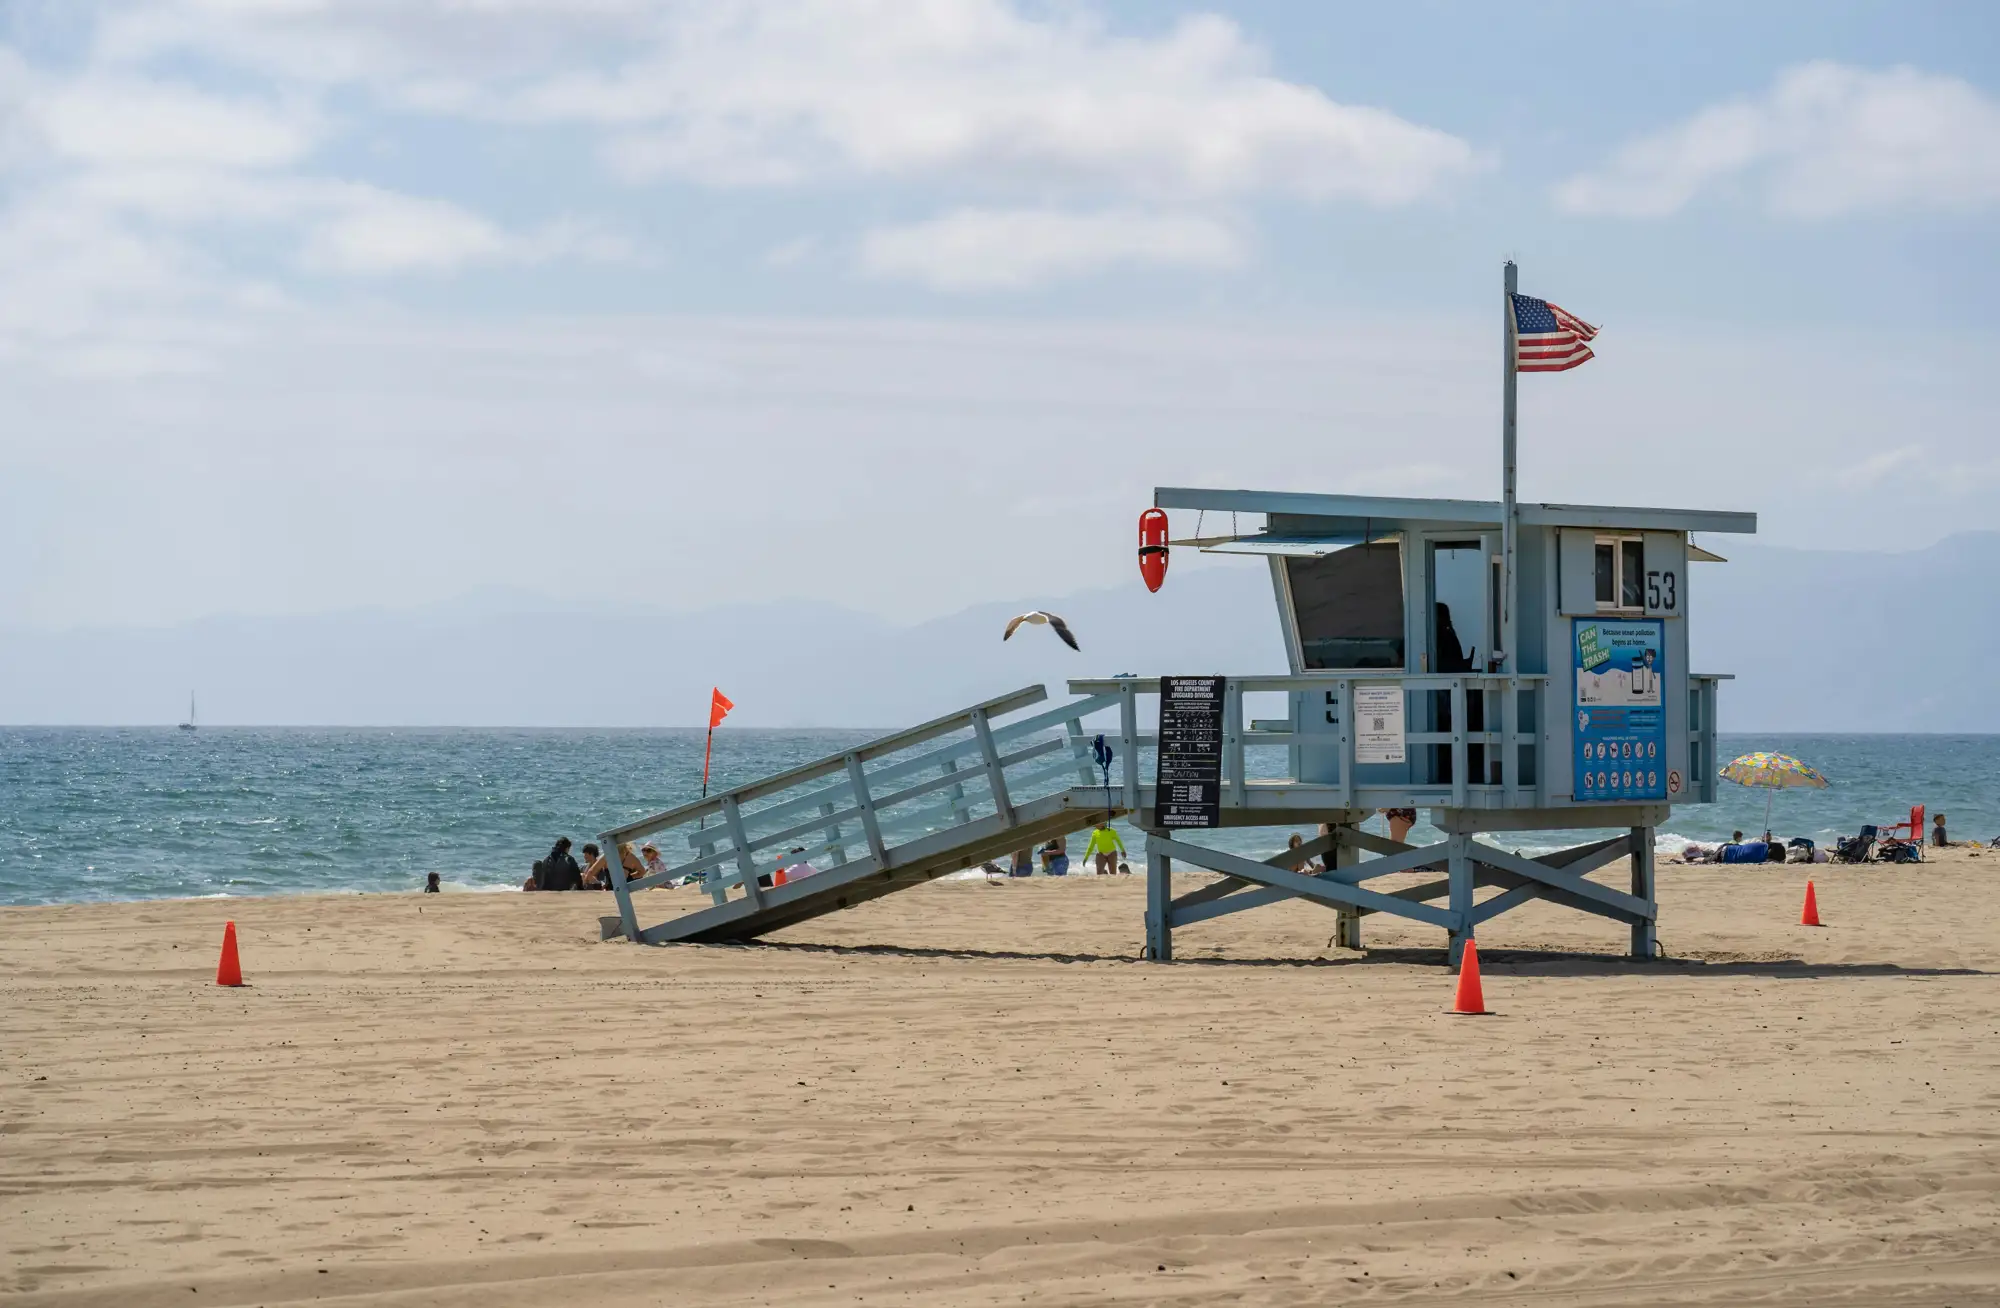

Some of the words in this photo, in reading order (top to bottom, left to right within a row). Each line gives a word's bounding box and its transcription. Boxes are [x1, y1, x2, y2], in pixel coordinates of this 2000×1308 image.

[1646, 571, 1676, 610] 53
[1580, 627, 1596, 644] CAN
[1602, 628, 1621, 636] Because
[1635, 629, 1656, 637] pollution
[1581, 641, 1597, 655] THE
[1611, 639, 1626, 647] begins
[1583, 648, 1610, 668] TRASH!
